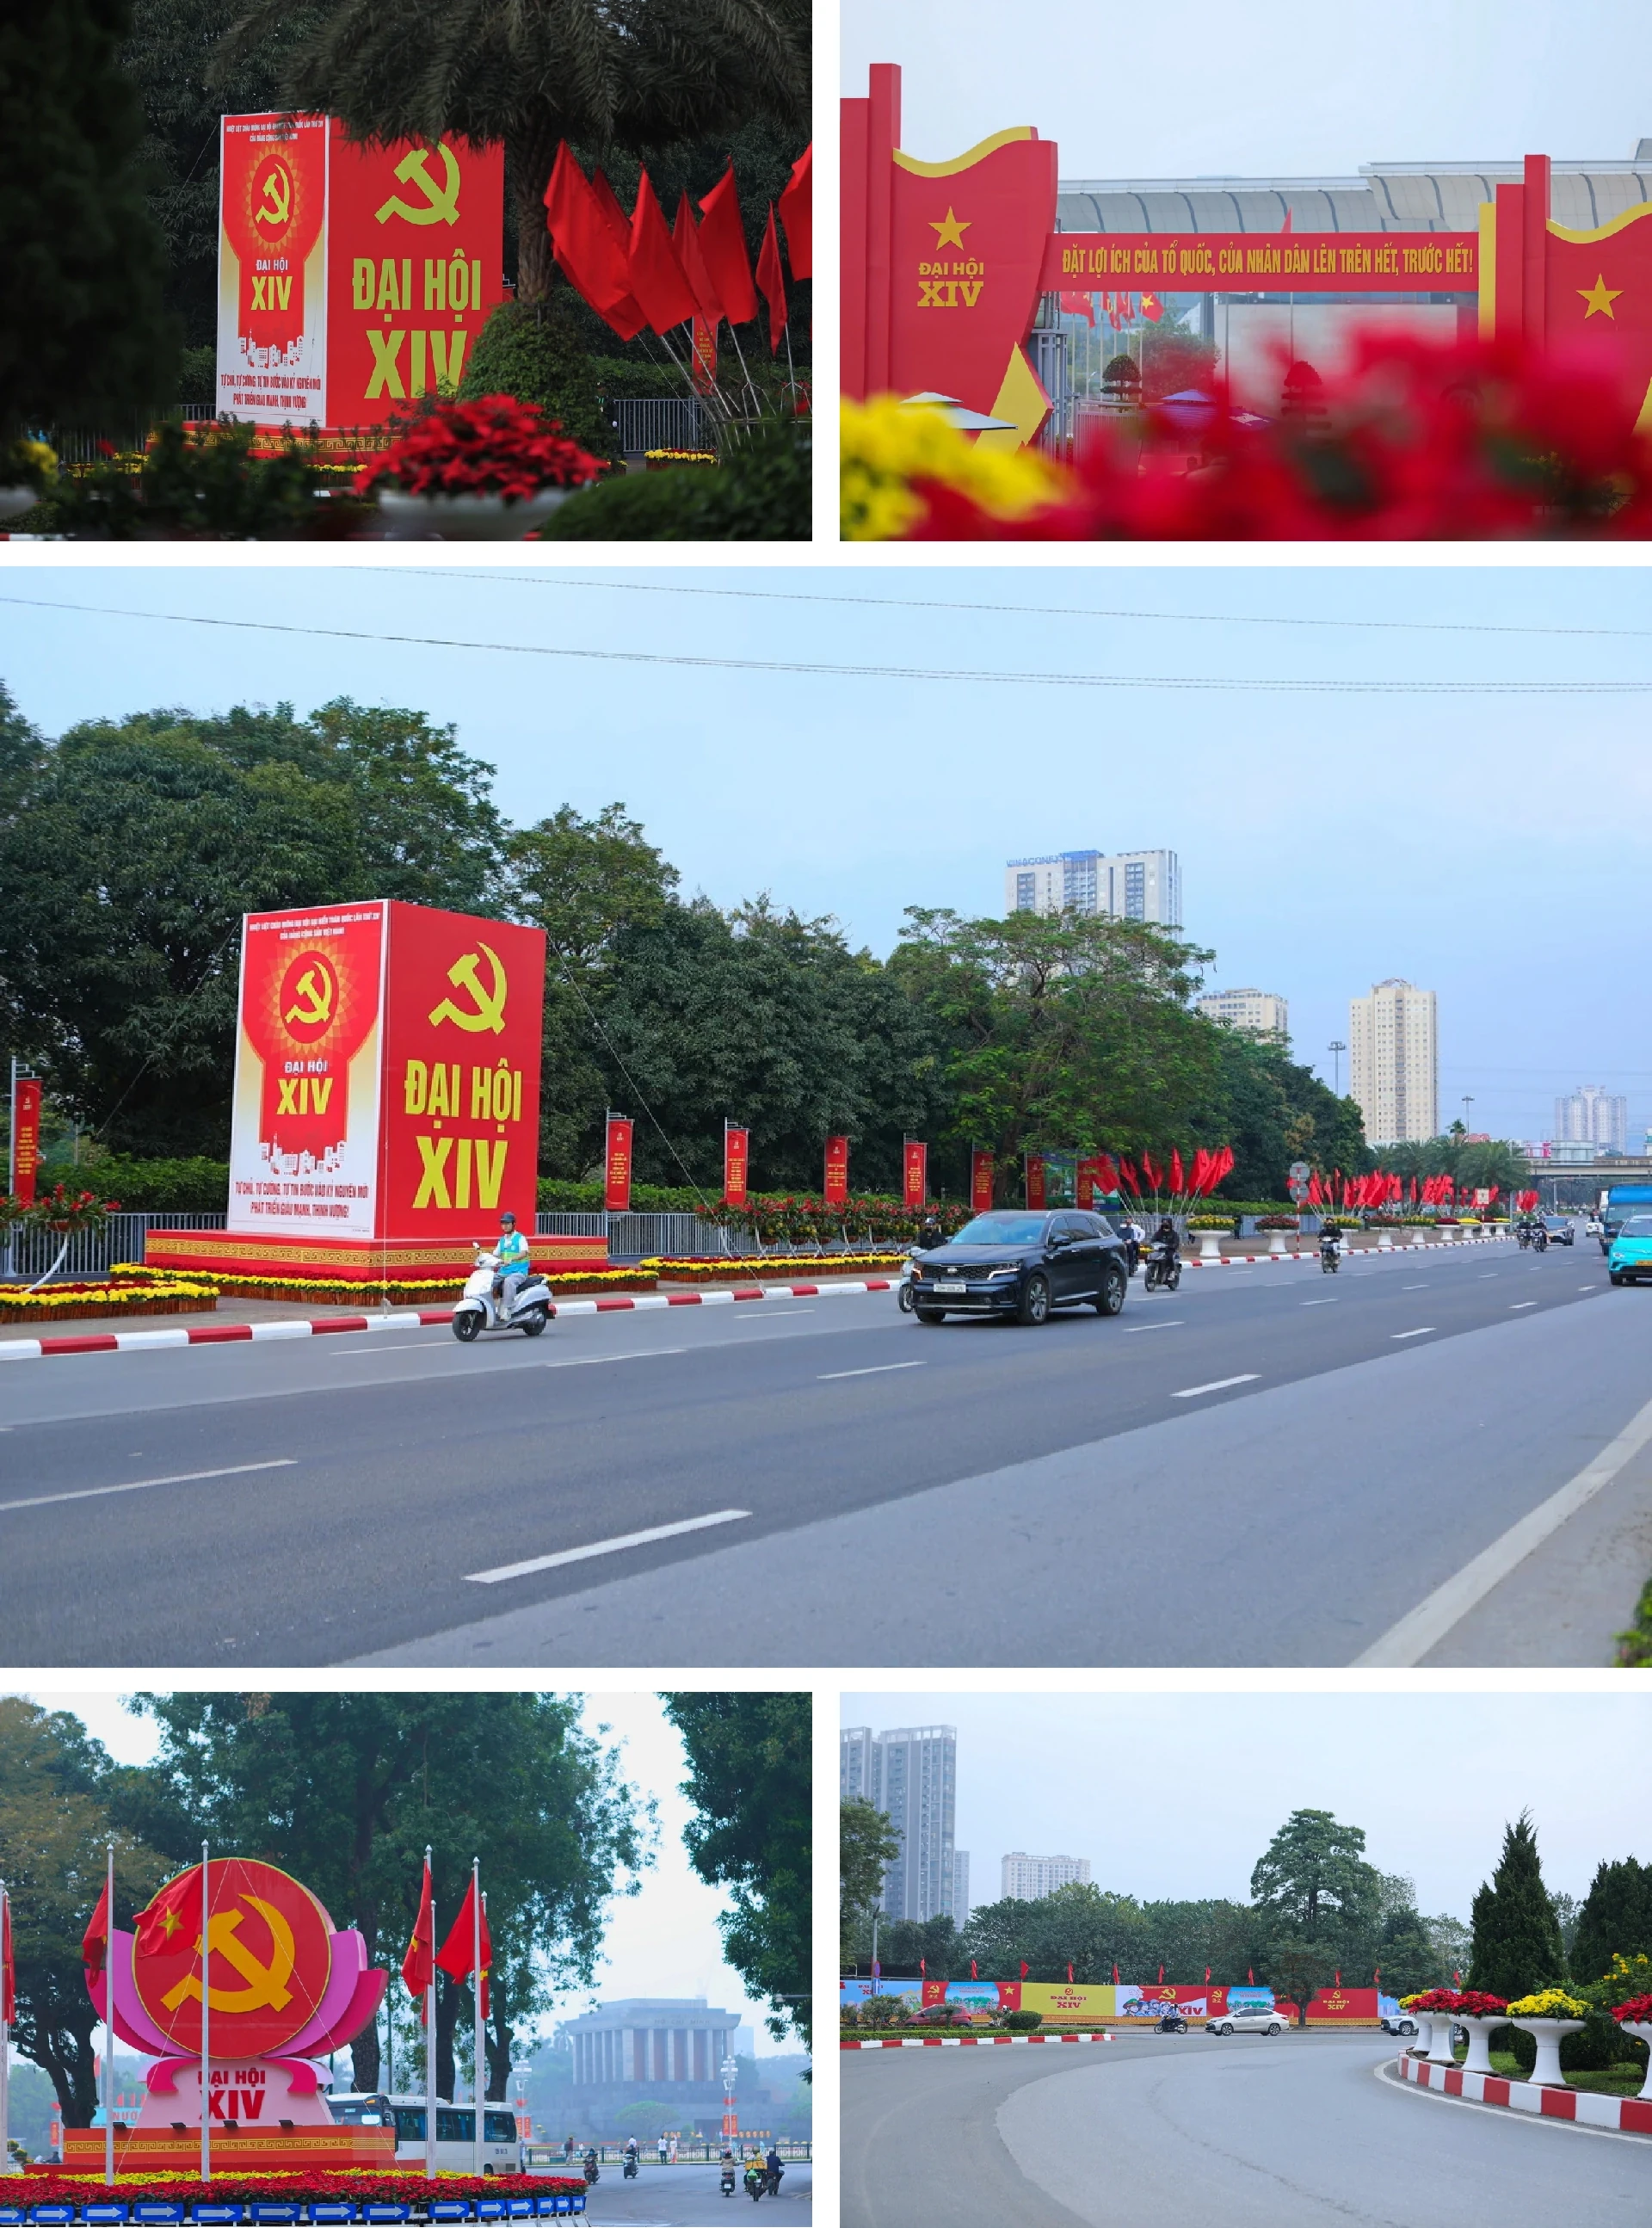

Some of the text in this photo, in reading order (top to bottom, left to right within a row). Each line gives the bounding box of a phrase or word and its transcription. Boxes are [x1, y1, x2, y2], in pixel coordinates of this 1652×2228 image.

[256, 256, 287, 273] ĐẠI HỘI
[919, 258, 984, 279] ĐẠI HỘI
[1063, 239, 1473, 278] ĐẶT LỢI ÍCH CỦA TỔ QUỐC, CỦA NHÂN DÂN LÊN TRÊN HẾT, TRƯỚC HẾT!
[251, 276, 293, 310] XIV
[352, 248, 481, 323] ĐẠI HỘI
[917, 281, 984, 306] XIV
[363, 330, 468, 399] XIV
[284, 1058, 328, 1076] ĐẠI HỘI
[277, 1078, 333, 1114] XIV
[404, 1058, 521, 1133] ĐẠI HỘI
[413, 1136, 508, 1209] XIV
[235, 2067, 265, 2088] HỘI
[199, 2089, 265, 2120] XIV
